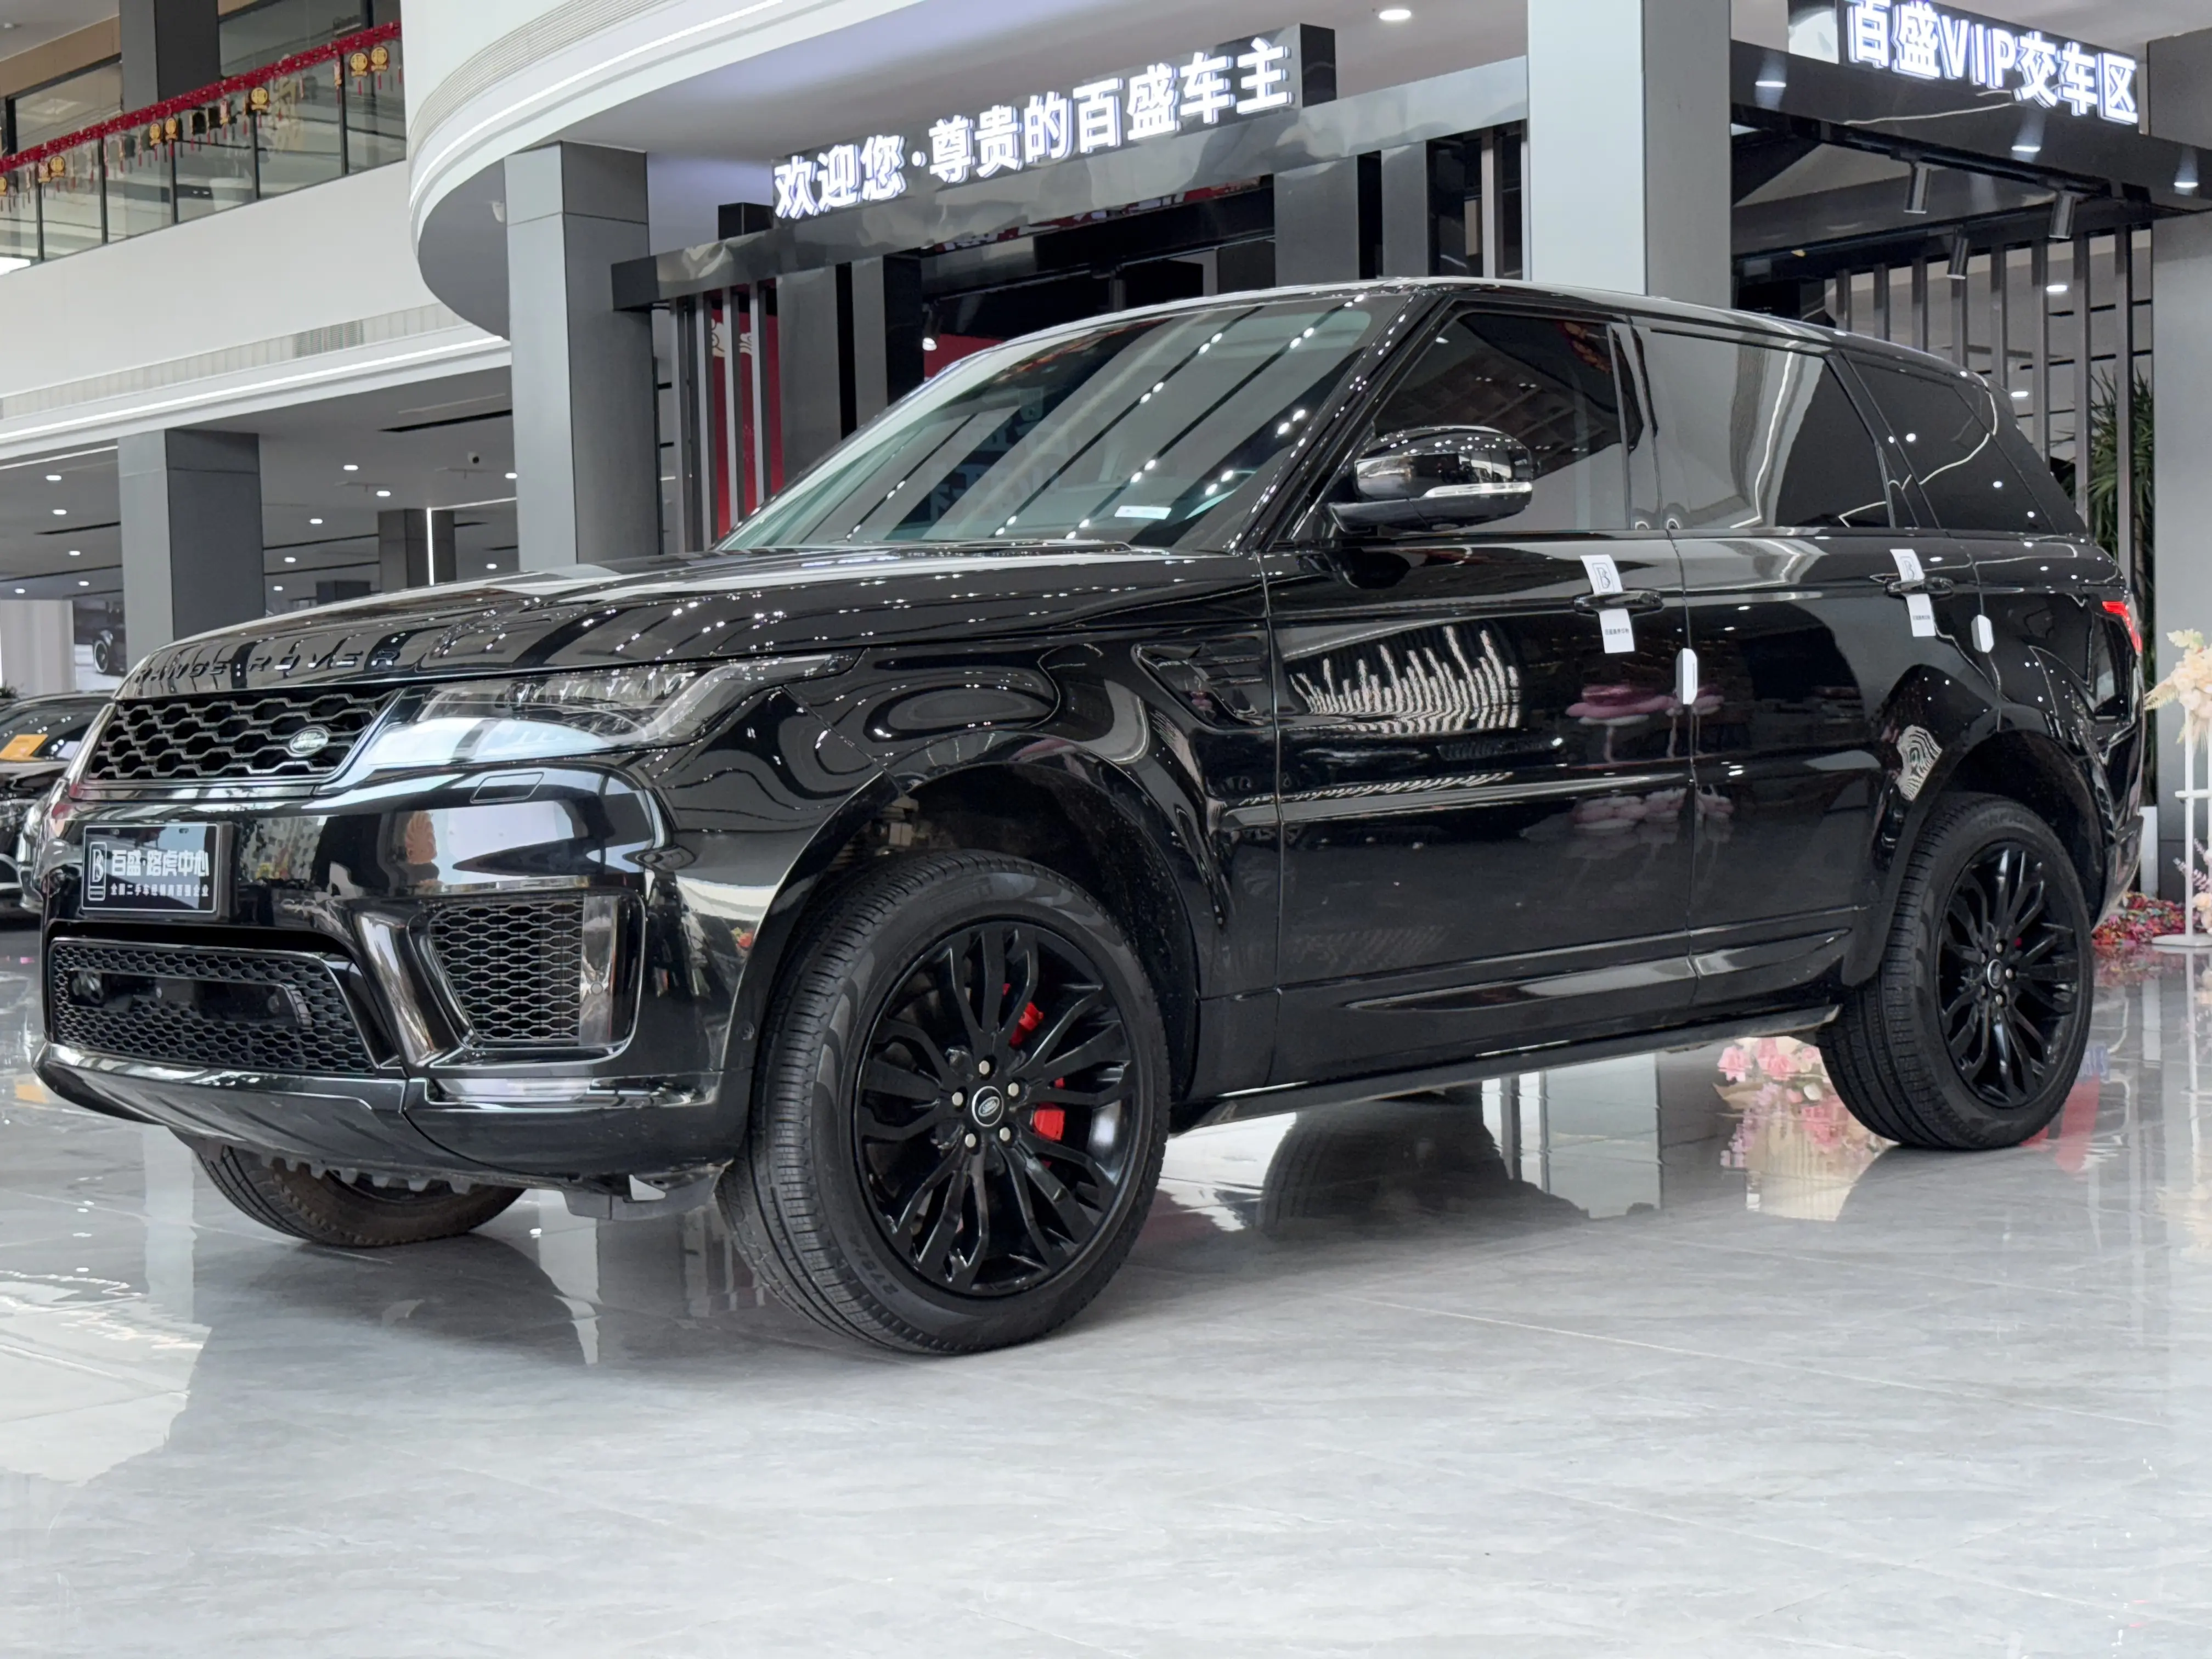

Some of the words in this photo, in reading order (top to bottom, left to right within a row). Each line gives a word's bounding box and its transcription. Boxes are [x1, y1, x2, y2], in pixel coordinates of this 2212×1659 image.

[1847, 0, 2138, 125] 百盛VIP交车区
